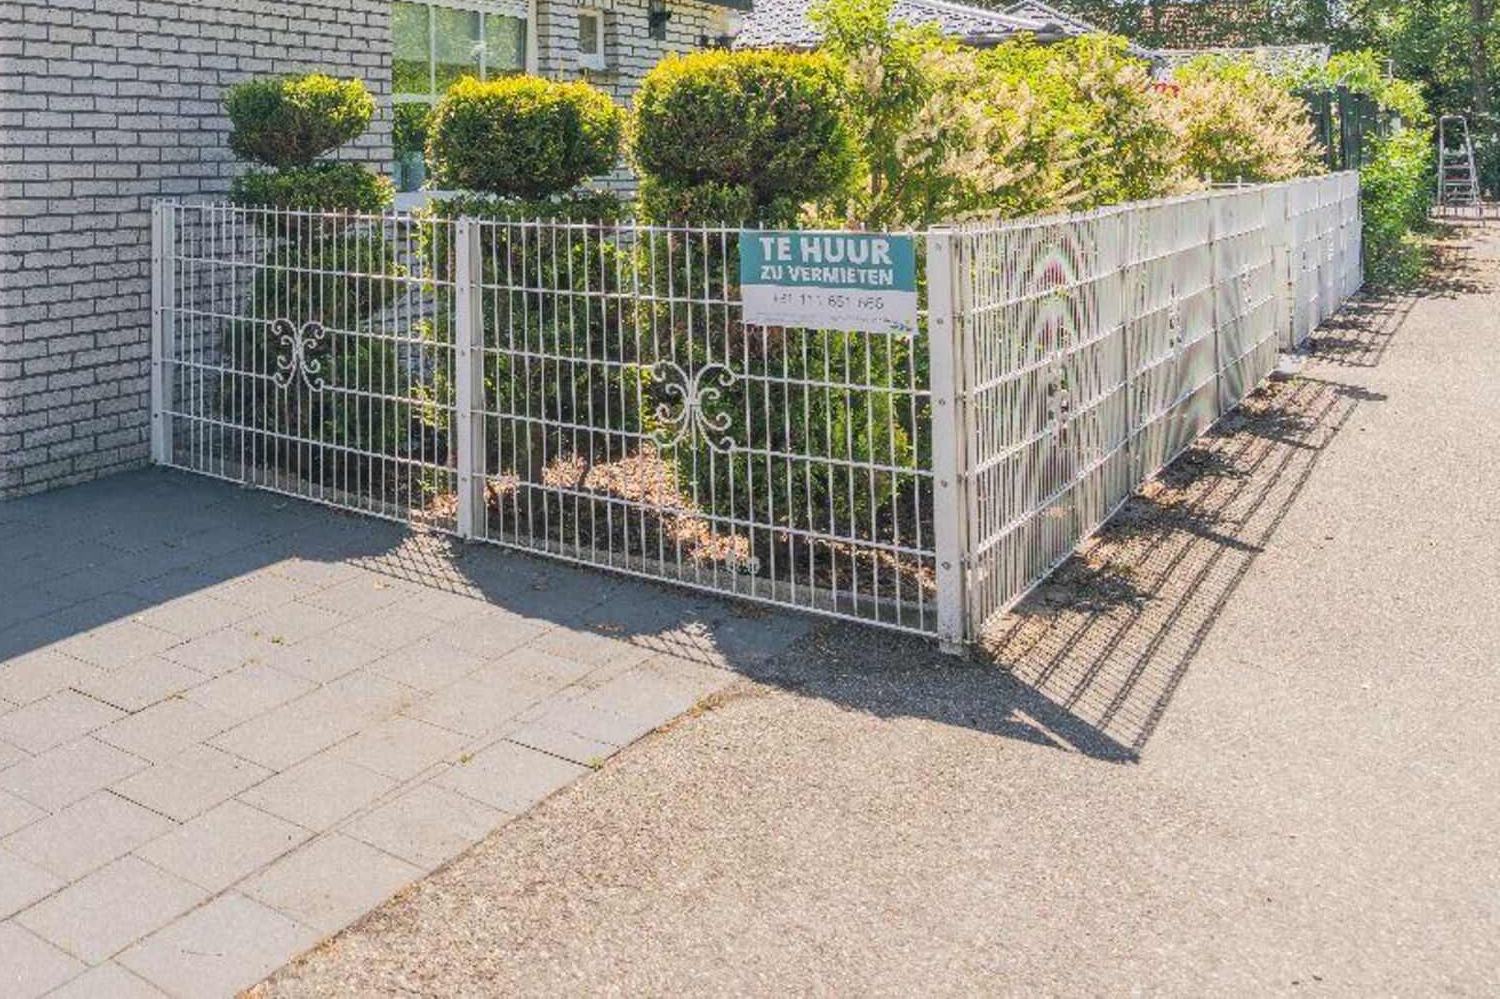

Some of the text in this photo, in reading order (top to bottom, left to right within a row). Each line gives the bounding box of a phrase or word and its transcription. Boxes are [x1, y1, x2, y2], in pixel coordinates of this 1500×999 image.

[759, 237, 893, 265] TE HUUR
[760, 265, 894, 285] ZU VERMIETEN
